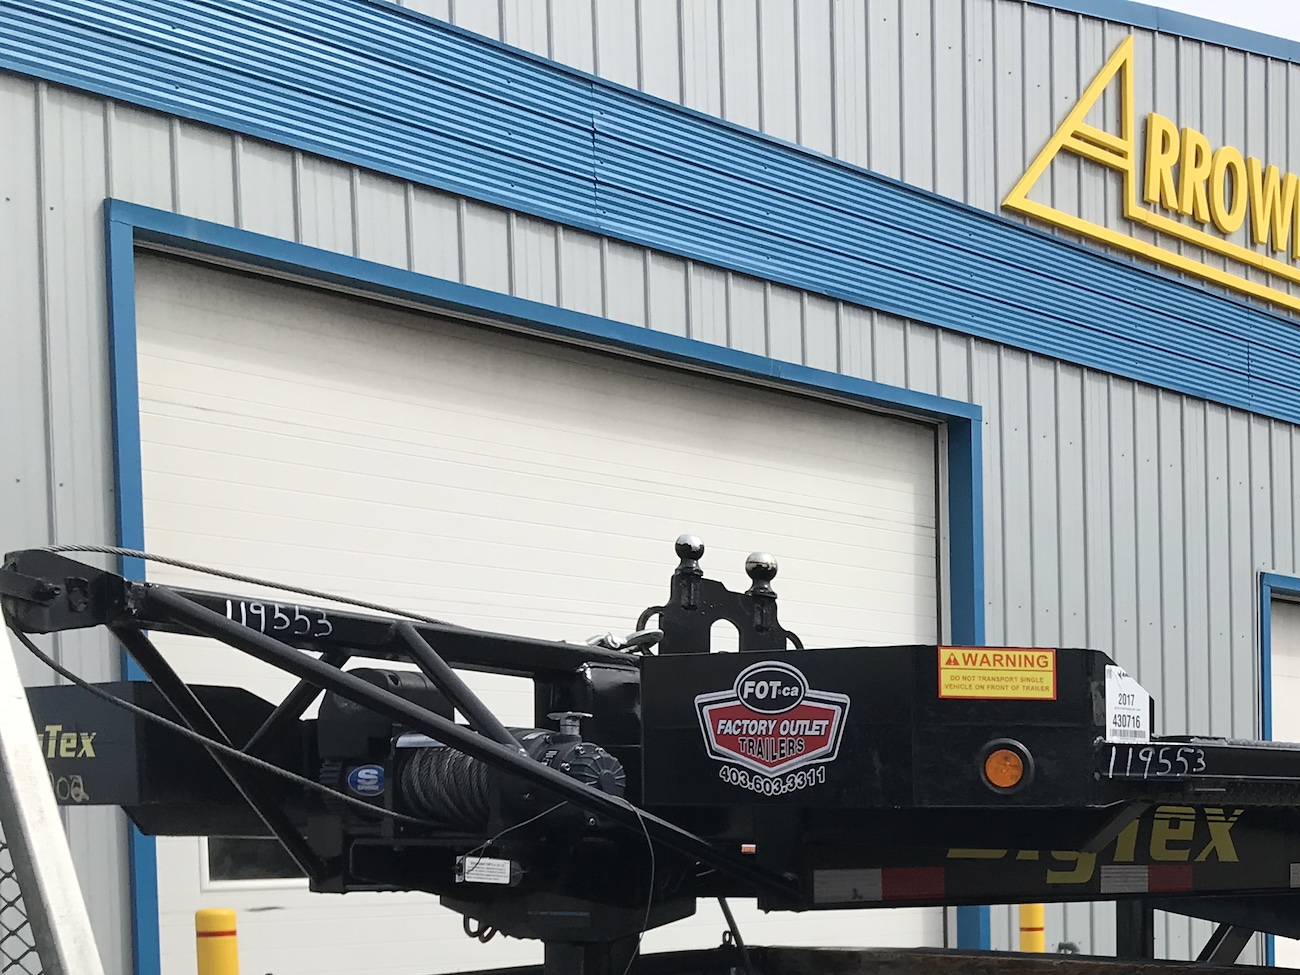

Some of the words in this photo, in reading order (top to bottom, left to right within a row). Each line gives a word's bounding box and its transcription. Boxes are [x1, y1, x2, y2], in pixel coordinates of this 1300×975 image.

[226, 600, 333, 637] 119553
[961, 652, 1049, 668] WARNING
[978, 675, 1018, 683] TRANSPORT
[1118, 693, 1135, 706] 2017
[717, 719, 777, 736] FACTORY
[779, 719, 829, 736] OUTLET
[1112, 714, 1141, 728] 430716
[739, 737, 805, 763] TRAILERS
[1108, 745, 1206, 779] 119553
[719, 765, 826, 796] 403.603.3311
